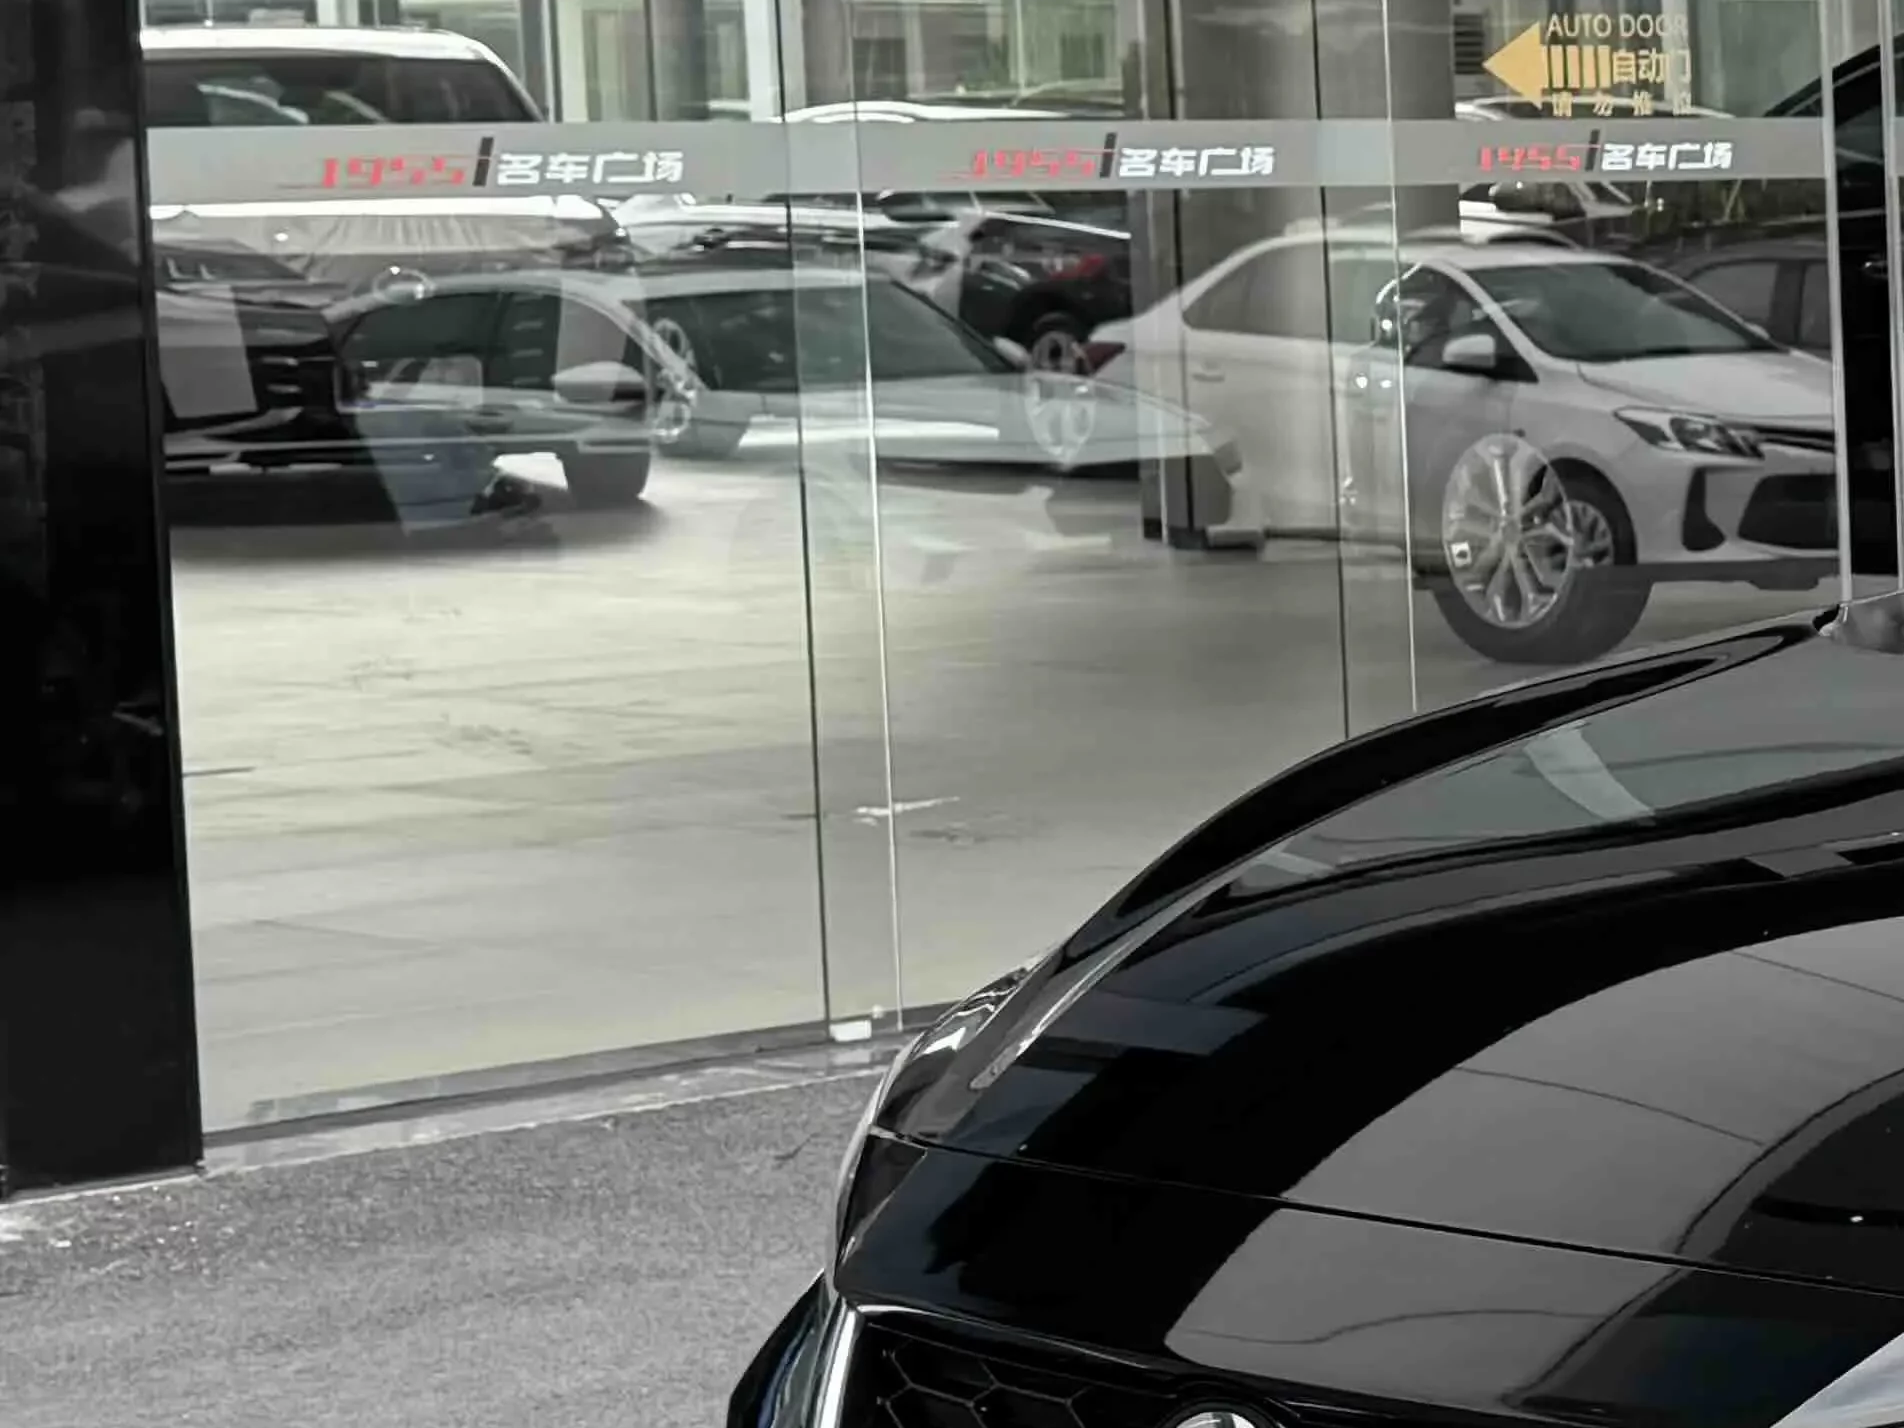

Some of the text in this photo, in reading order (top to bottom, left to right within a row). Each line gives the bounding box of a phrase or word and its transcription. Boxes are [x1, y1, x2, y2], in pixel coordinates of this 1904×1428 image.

[1546, 13, 1688, 39] AUTO DOOR
[1613, 48, 1692, 84] 自动门
[320, 150, 684, 188] 1955 名车广场
[1118, 147, 1275, 177] 名车广场
[1601, 141, 1734, 171] 名车广场
